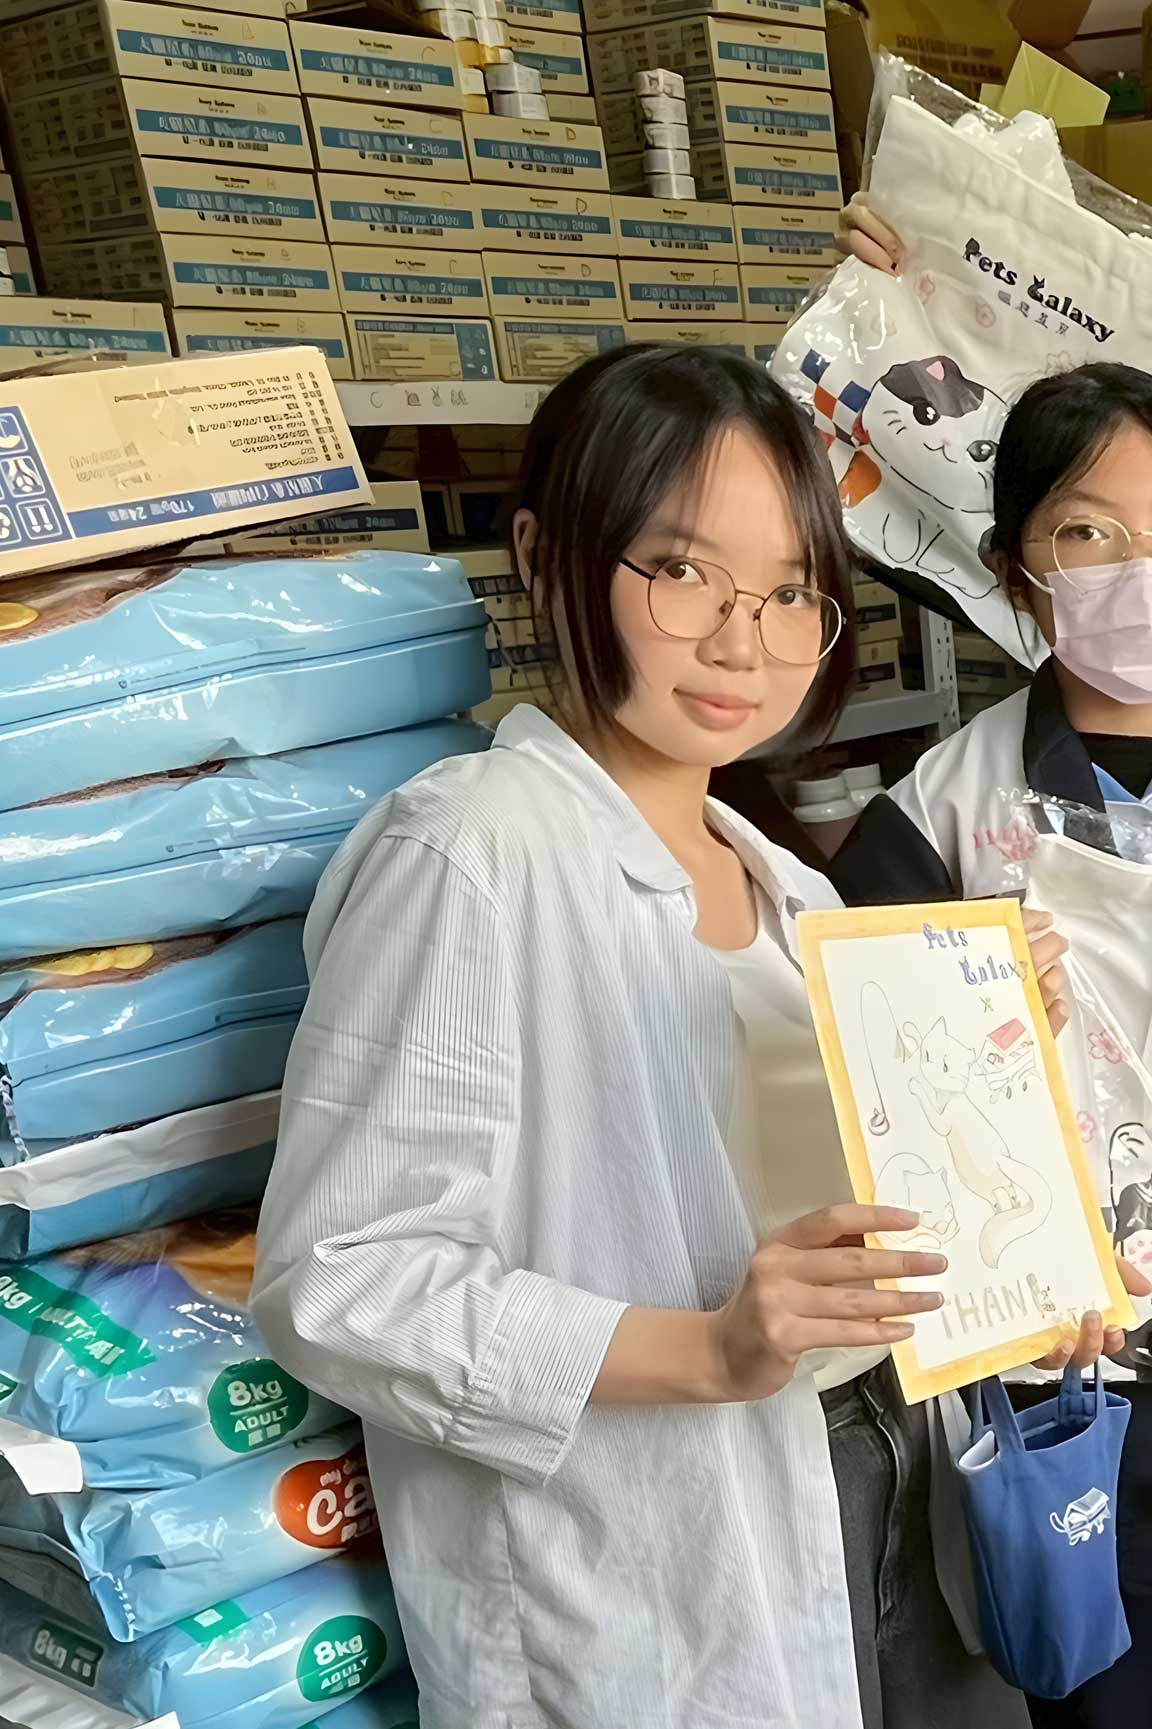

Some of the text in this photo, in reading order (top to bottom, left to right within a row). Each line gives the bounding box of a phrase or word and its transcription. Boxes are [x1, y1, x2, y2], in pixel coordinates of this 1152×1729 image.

[227, 1379, 284, 1408] 8kg
[233, 1405, 289, 1434] ADULT
[314, 1634, 365, 1667] 8kg
